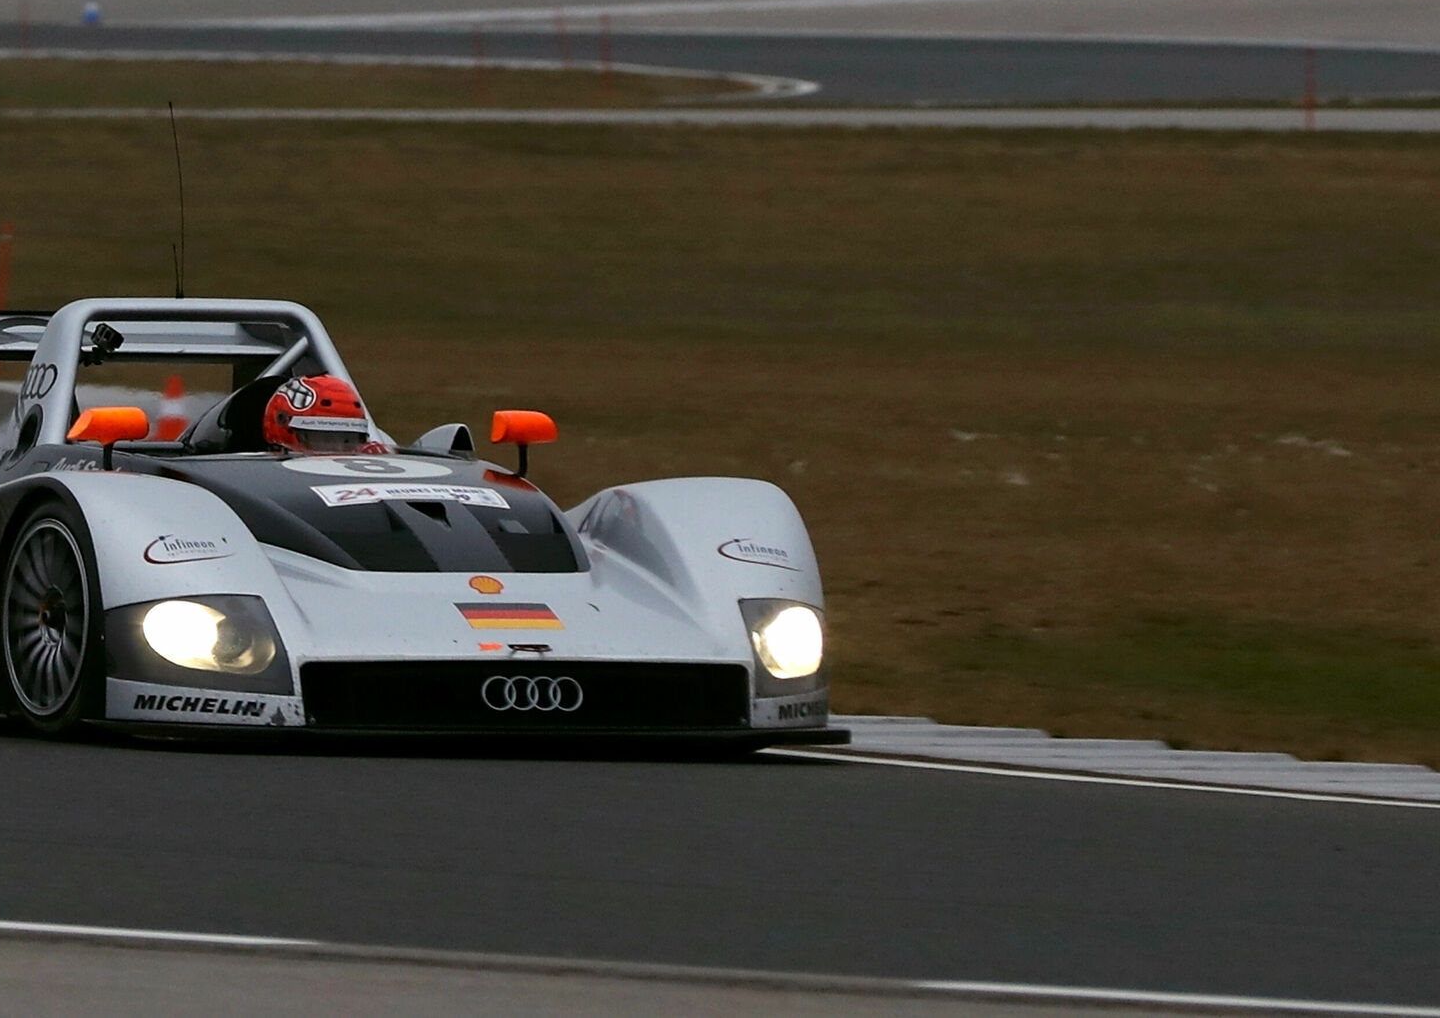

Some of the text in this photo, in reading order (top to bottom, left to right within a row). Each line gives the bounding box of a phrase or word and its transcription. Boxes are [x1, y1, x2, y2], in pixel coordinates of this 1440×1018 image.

[333, 457, 406, 474] 8
[335, 488, 378, 501] 24
[385, 487, 431, 495] HEURES
[163, 539, 216, 552] Infineon
[737, 543, 789, 558] Infineon
[133, 694, 267, 717] MICHELIN
